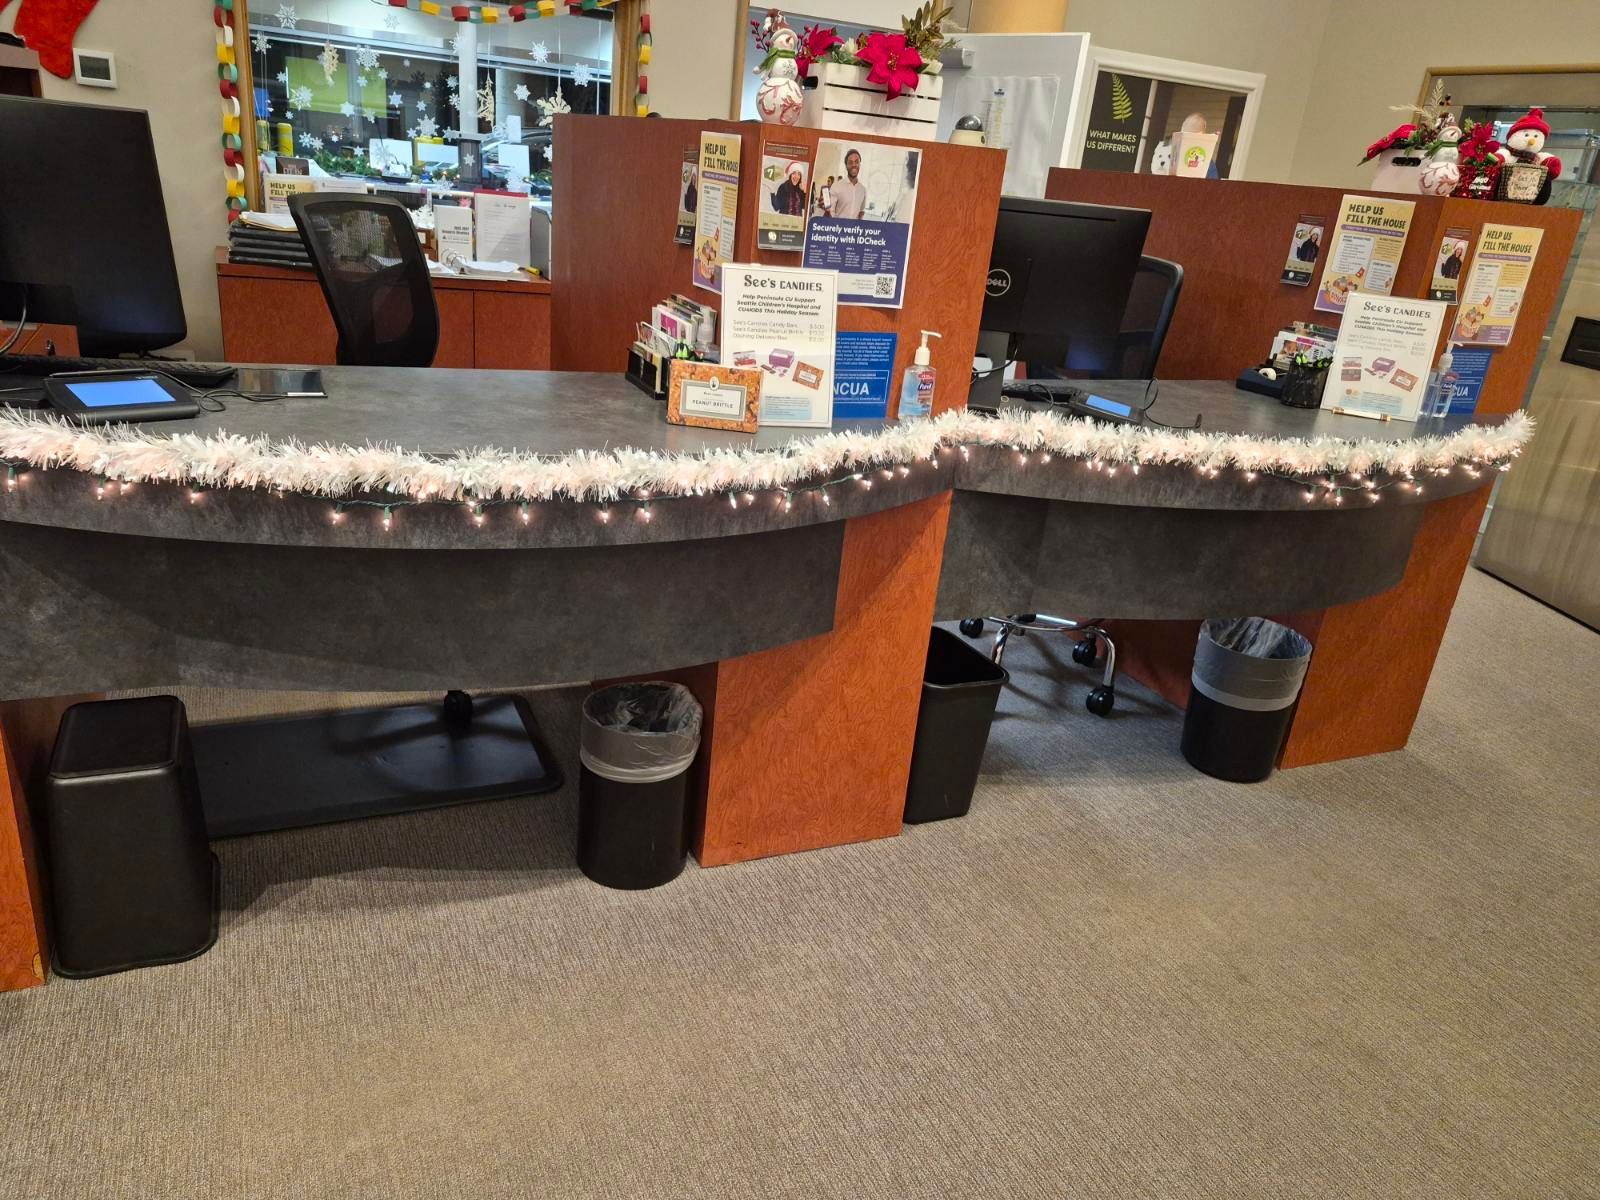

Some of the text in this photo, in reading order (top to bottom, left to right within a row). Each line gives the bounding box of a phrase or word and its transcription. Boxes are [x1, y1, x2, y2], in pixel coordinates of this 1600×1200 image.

[1089, 129, 1137, 143] WHAT MAKES
[704, 143, 727, 156] HELP US
[1086, 141, 1136, 154] US DIFFERENT
[704, 157, 716, 169] FILL
[716, 159, 726, 171] THE
[269, 182, 287, 190] HELP
[1349, 203, 1385, 216] HELP US
[1345, 213, 1407, 230] FILL THE HOUSE
[812, 222, 842, 234] Securely
[843, 226, 863, 236] verify
[1486, 230, 1513, 241] HELP US
[811, 233, 887, 246] identity with IDCheck
[1482, 241, 1533, 254] FILL THE HOUSE
[744, 274, 822, 292] See's CANDIES
[986, 278, 1007, 287] DELL
[742, 293, 756, 301] Help
[1363, 301, 1431, 319] See's CANDIES
